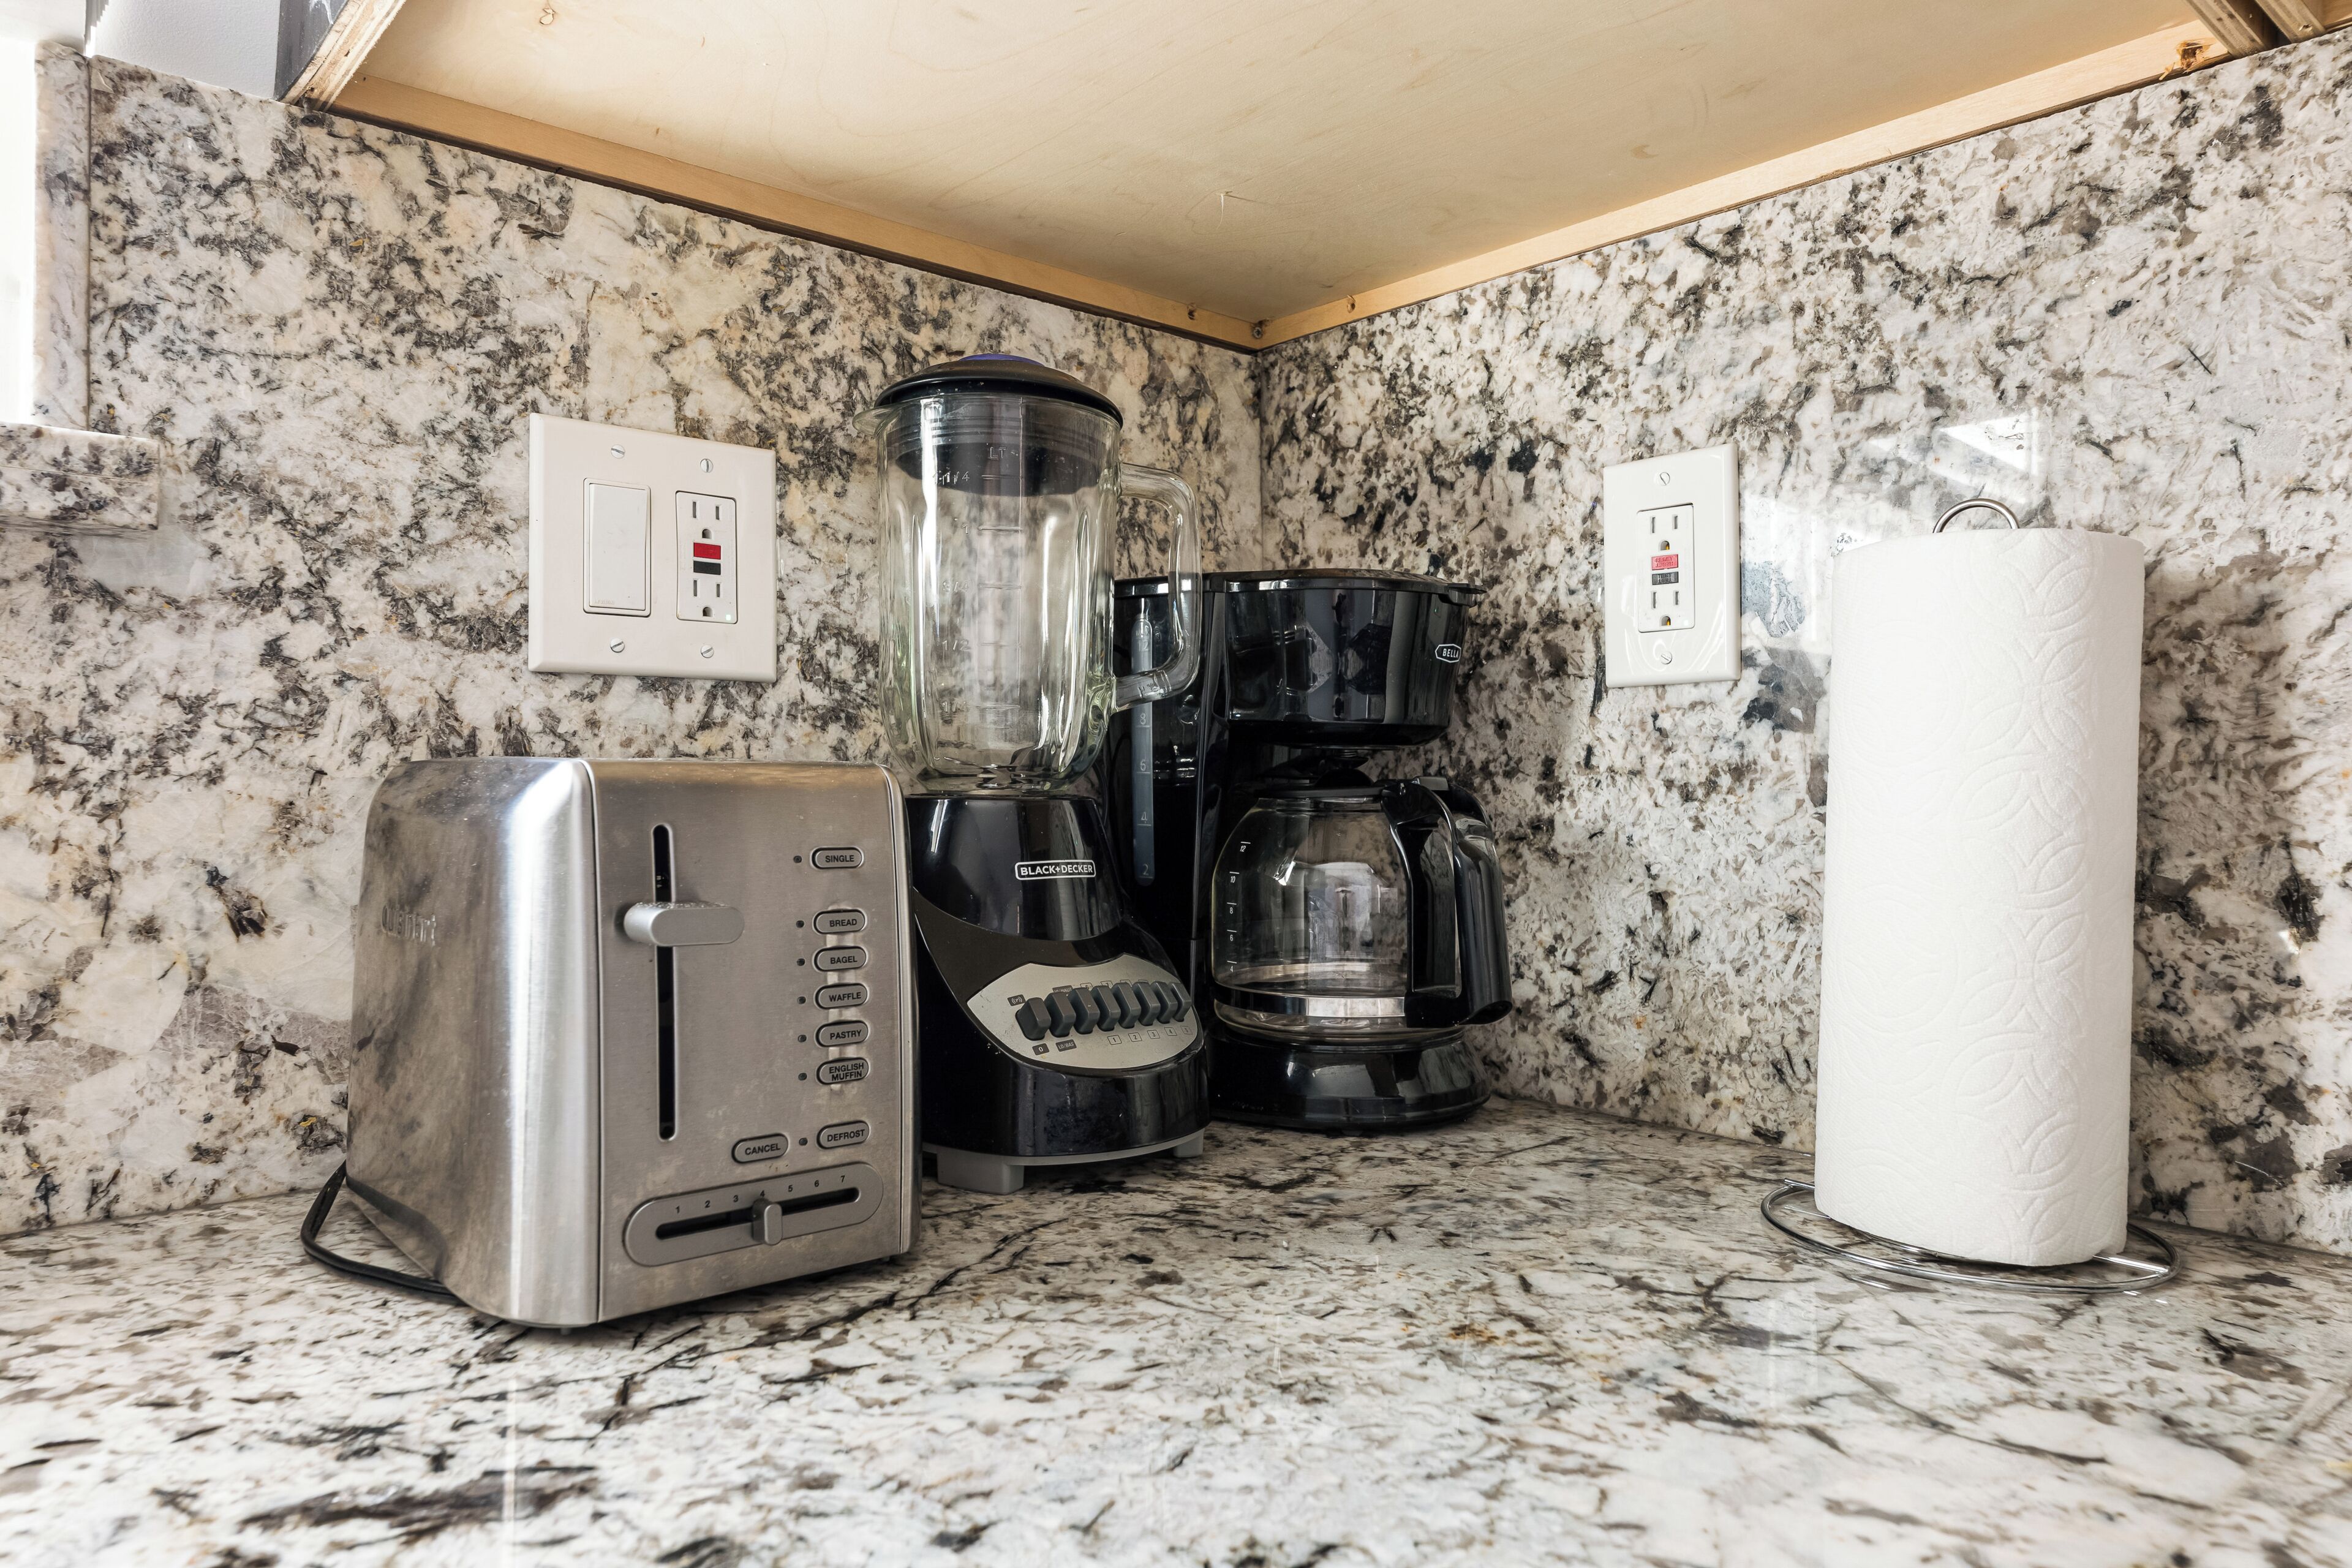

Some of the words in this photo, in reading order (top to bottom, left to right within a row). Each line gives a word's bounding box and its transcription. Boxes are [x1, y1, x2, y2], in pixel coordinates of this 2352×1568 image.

[1442, 648, 1459, 658] BELLA
[1140, 713, 1147, 726] 8
[1140, 759, 1147, 772] 6
[1141, 812, 1148, 824] 4
[825, 854, 854, 863] SINGLE
[1020, 864, 1093, 875] BLACK+DECKER
[1142, 864, 1150, 875] 2
[829, 919, 858, 927] BREAD
[830, 956, 858, 964] BAGEL
[829, 992, 862, 1002] WAFFLE
[830, 1030, 862, 1040] PASTRY
[829, 1062, 864, 1074] ENGLISH
[832, 1070, 862, 1081] MUFFIN
[827, 1129, 865, 1142] DEFROST
[745, 1143, 781, 1156] CANCEL
[704, 1200, 710, 1208] 2
